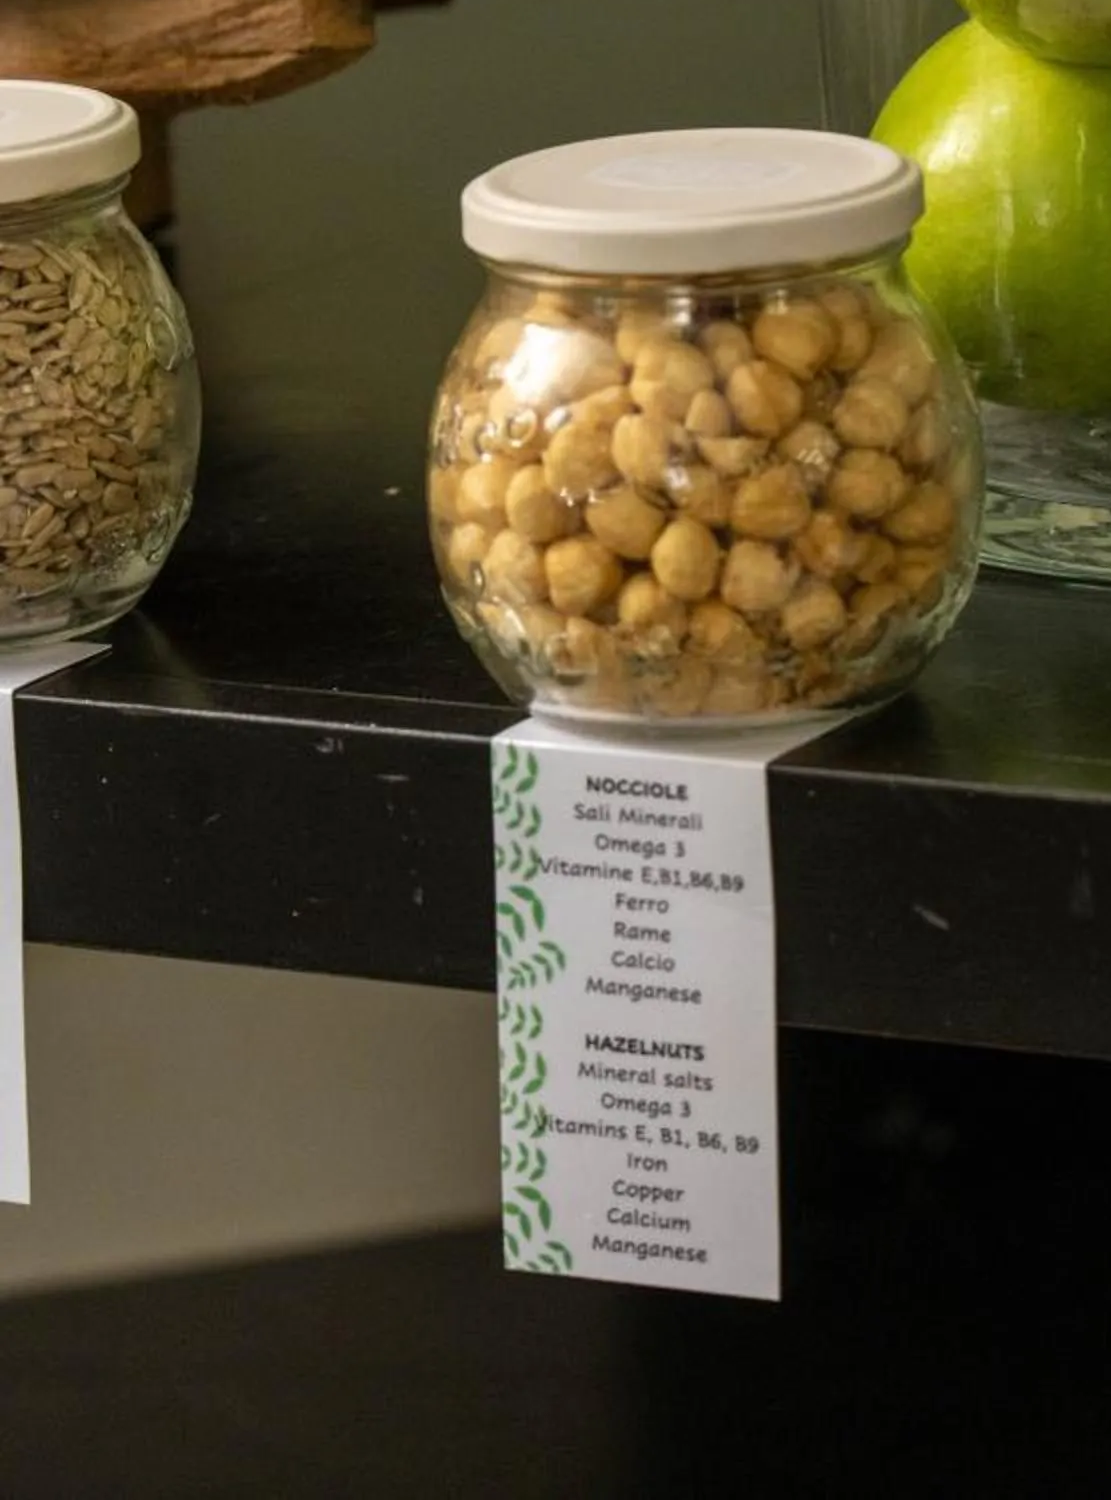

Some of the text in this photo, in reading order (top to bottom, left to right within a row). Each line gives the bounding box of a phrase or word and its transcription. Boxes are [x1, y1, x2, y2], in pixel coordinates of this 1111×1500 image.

[585, 776, 689, 801] NOCCIOLE
[573, 803, 705, 831] Sali Minerali
[594, 833, 688, 860] Omega 3
[538, 856, 634, 882] Vitamine
[614, 892, 670, 915] Ferro
[612, 921, 672, 944] Rame
[610, 950, 676, 973] Calcio
[585, 976, 703, 1005] Manganese
[585, 1033, 706, 1062] HAZELNUTS
[577, 1062, 715, 1092] Mineral salts
[600, 1092, 692, 1119] Omega 3
[634, 1126, 654, 1144] E,
[660, 1127, 690, 1150] B1,
[696, 1130, 728, 1155] B6,
[734, 1135, 760, 1155] B9
[626, 1151, 669, 1174] Iron
[612, 1179, 686, 1206] Copper
[606, 1207, 692, 1232] Calcium
[590, 1236, 708, 1264] Manganese
